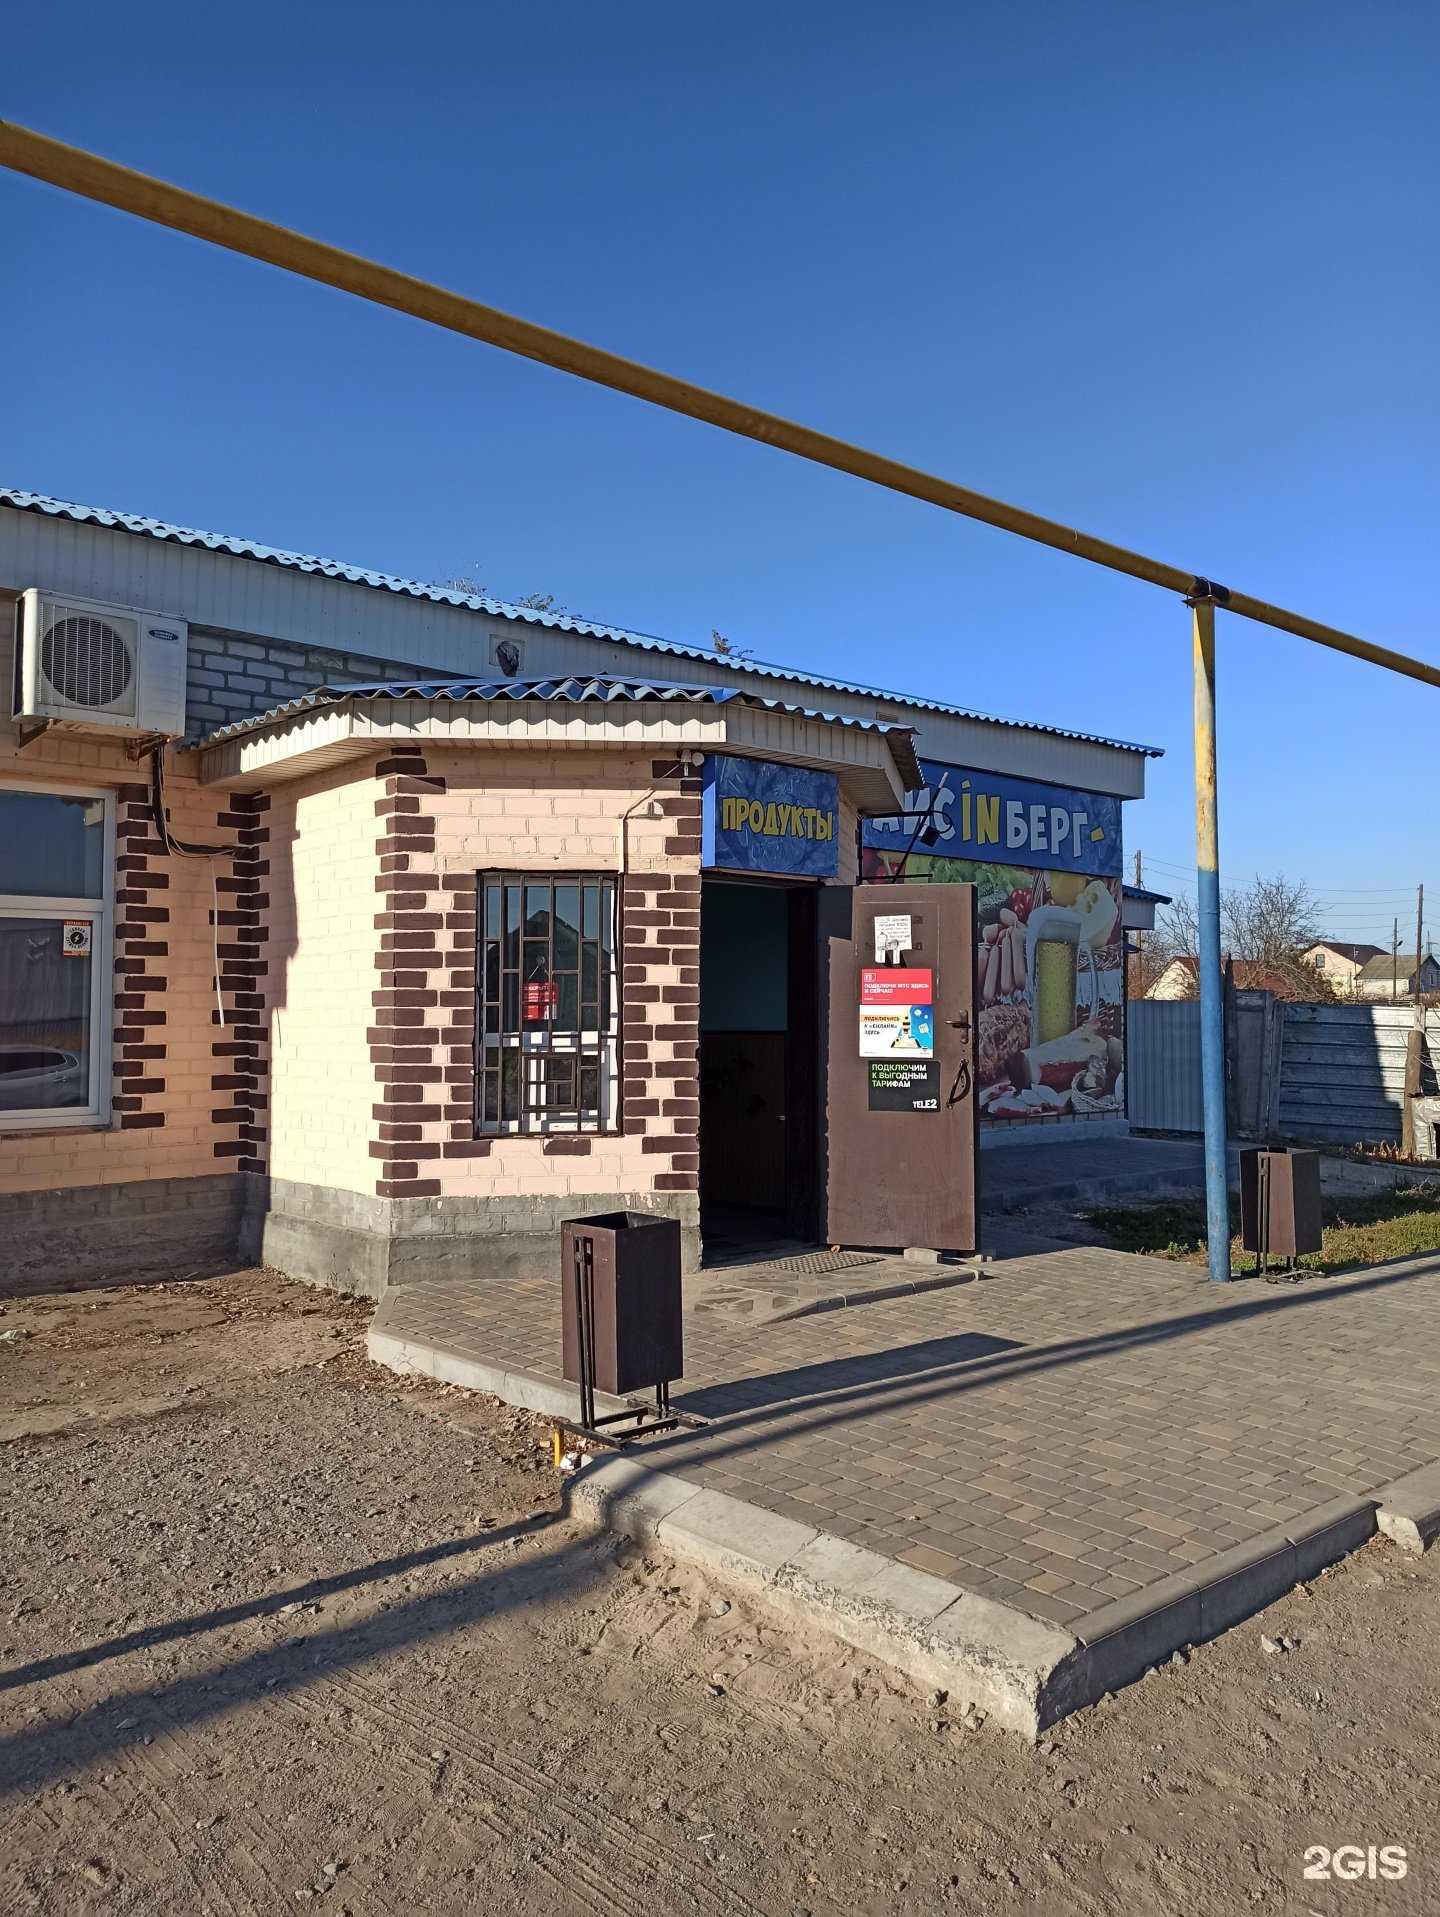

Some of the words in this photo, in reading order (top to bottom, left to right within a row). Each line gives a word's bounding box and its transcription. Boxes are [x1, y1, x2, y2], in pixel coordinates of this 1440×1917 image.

[722, 797, 834, 841] ПРОДУКТЫ
[871, 1063, 927, 1072] ПОДКЛЮЧИМ
[879, 1072, 928, 1080] ВЫГОДНЫМ
[872, 1080, 911, 1088] ТАРИФАМ
[912, 1098, 938, 1109] TELE2
